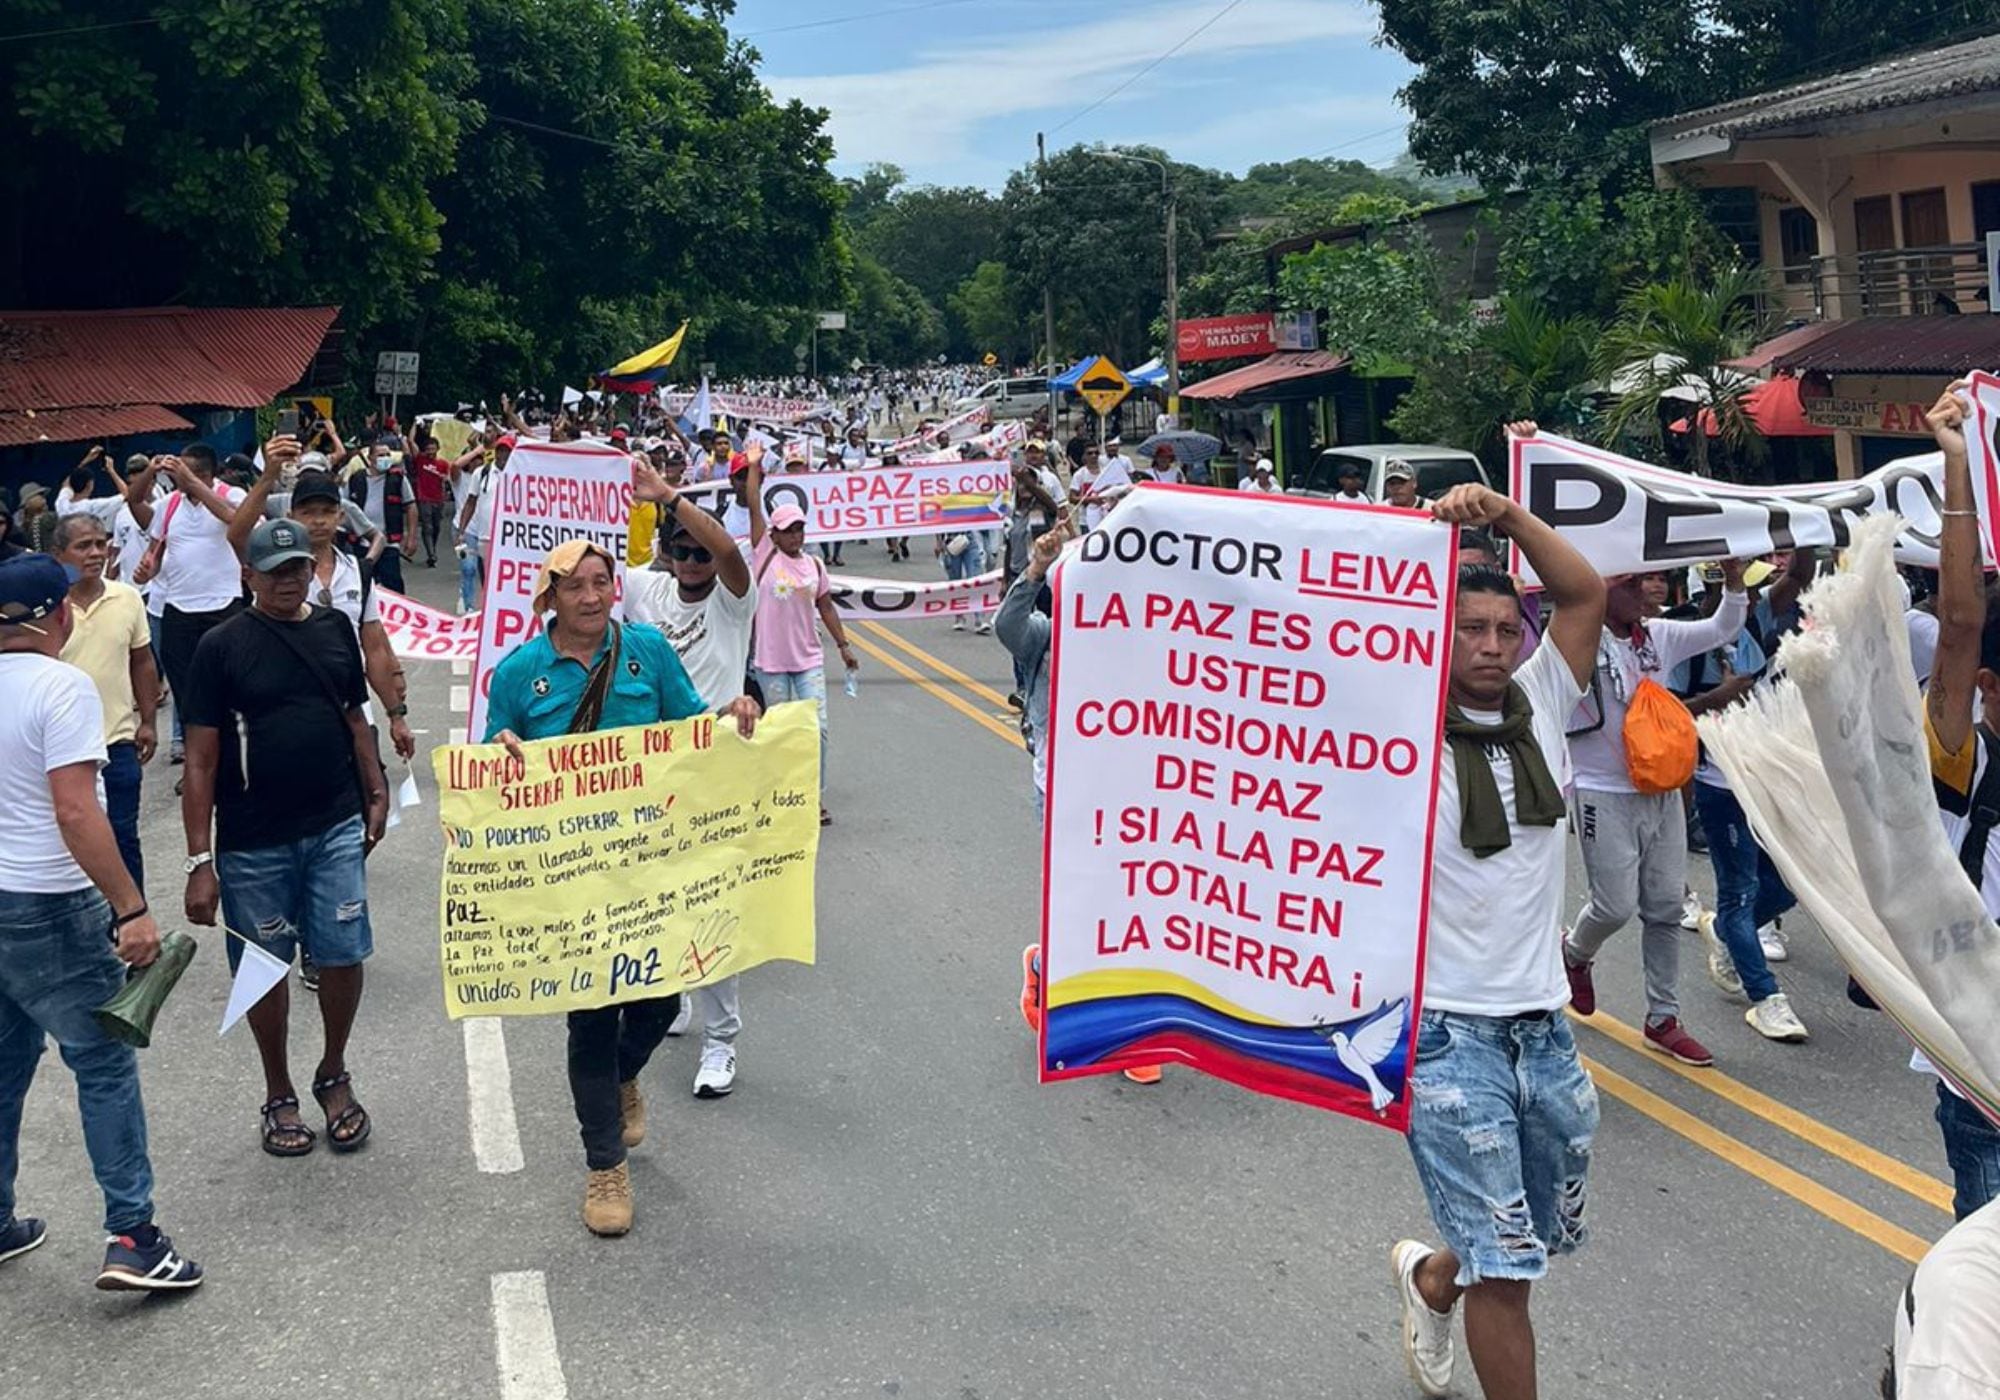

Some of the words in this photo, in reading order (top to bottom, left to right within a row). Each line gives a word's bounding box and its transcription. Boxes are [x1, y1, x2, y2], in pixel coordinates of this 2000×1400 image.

[1199, 326, 1233, 336] TIENDA
[1235, 323, 1267, 334] DONDE
[1206, 332, 1260, 348] MADEY
[1807, 400, 1880, 416] RESTAURANTE
[503, 473, 523, 514] LO
[526, 475, 633, 526] ESPERAMOS
[812, 486, 845, 505] LA
[846, 473, 917, 502] PAZ
[919, 478, 951, 498] ES
[958, 473, 1010, 495] CON
[816, 501, 943, 530] USTED
[1080, 526, 1284, 582] DOCTOR
[1298, 547, 1438, 602] LEIVA
[924, 596, 970, 613] DE
[1074, 592, 1130, 630] LA
[1144, 593, 1236, 643] PAZ
[1248, 608, 1313, 653] ES
[1328, 618, 1436, 668] CON
[1167, 648, 1328, 709] USTED
[449, 749, 526, 791] LLAMADO
[548, 735, 628, 774] URGENTE
[643, 728, 674, 755] POR
[693, 717, 713, 750] LA
[1075, 699, 1419, 778] COMISIONADO
[499, 777, 564, 811] SIERRA
[575, 761, 644, 797] NEVADA
[1155, 754, 1216, 800] DE
[1230, 770, 1325, 823] PAZ
[446, 856, 502, 876] Hacemos
[507, 858, 528, 872] un
[539, 841, 594, 870] llamado
[603, 832, 650, 855] urgente
[661, 823, 675, 839] al
[689, 804, 742, 831] gobierno
[486, 823, 551, 849] PODEMOS
[559, 809, 624, 836] ESPERAR
[1094, 809, 1104, 846] !
[1118, 805, 1160, 847] SI
[1172, 810, 1202, 851] A
[1216, 820, 1274, 871] LA
[1288, 837, 1386, 888] PAZ
[1583, 803, 1597, 844] NIKE
[446, 872, 468, 896] las
[473, 872, 536, 893] entidades
[619, 858, 632, 868] a
[756, 815, 772, 829] de
[544, 918, 576, 935] miles
[582, 909, 597, 927] de
[1120, 859, 1262, 925] TOTAL
[1276, 891, 1344, 939] EN
[506, 936, 540, 955] total
[580, 929, 598, 942] no
[607, 904, 675, 934] entendemos
[1096, 914, 1150, 957] LA
[1164, 918, 1336, 996] SIERRA
[447, 960, 506, 977] territorio
[512, 959, 528, 970] no
[536, 954, 552, 965] se
[601, 937, 612, 951] el
[457, 978, 522, 1005] Unidos
[609, 946, 666, 996] Paz
